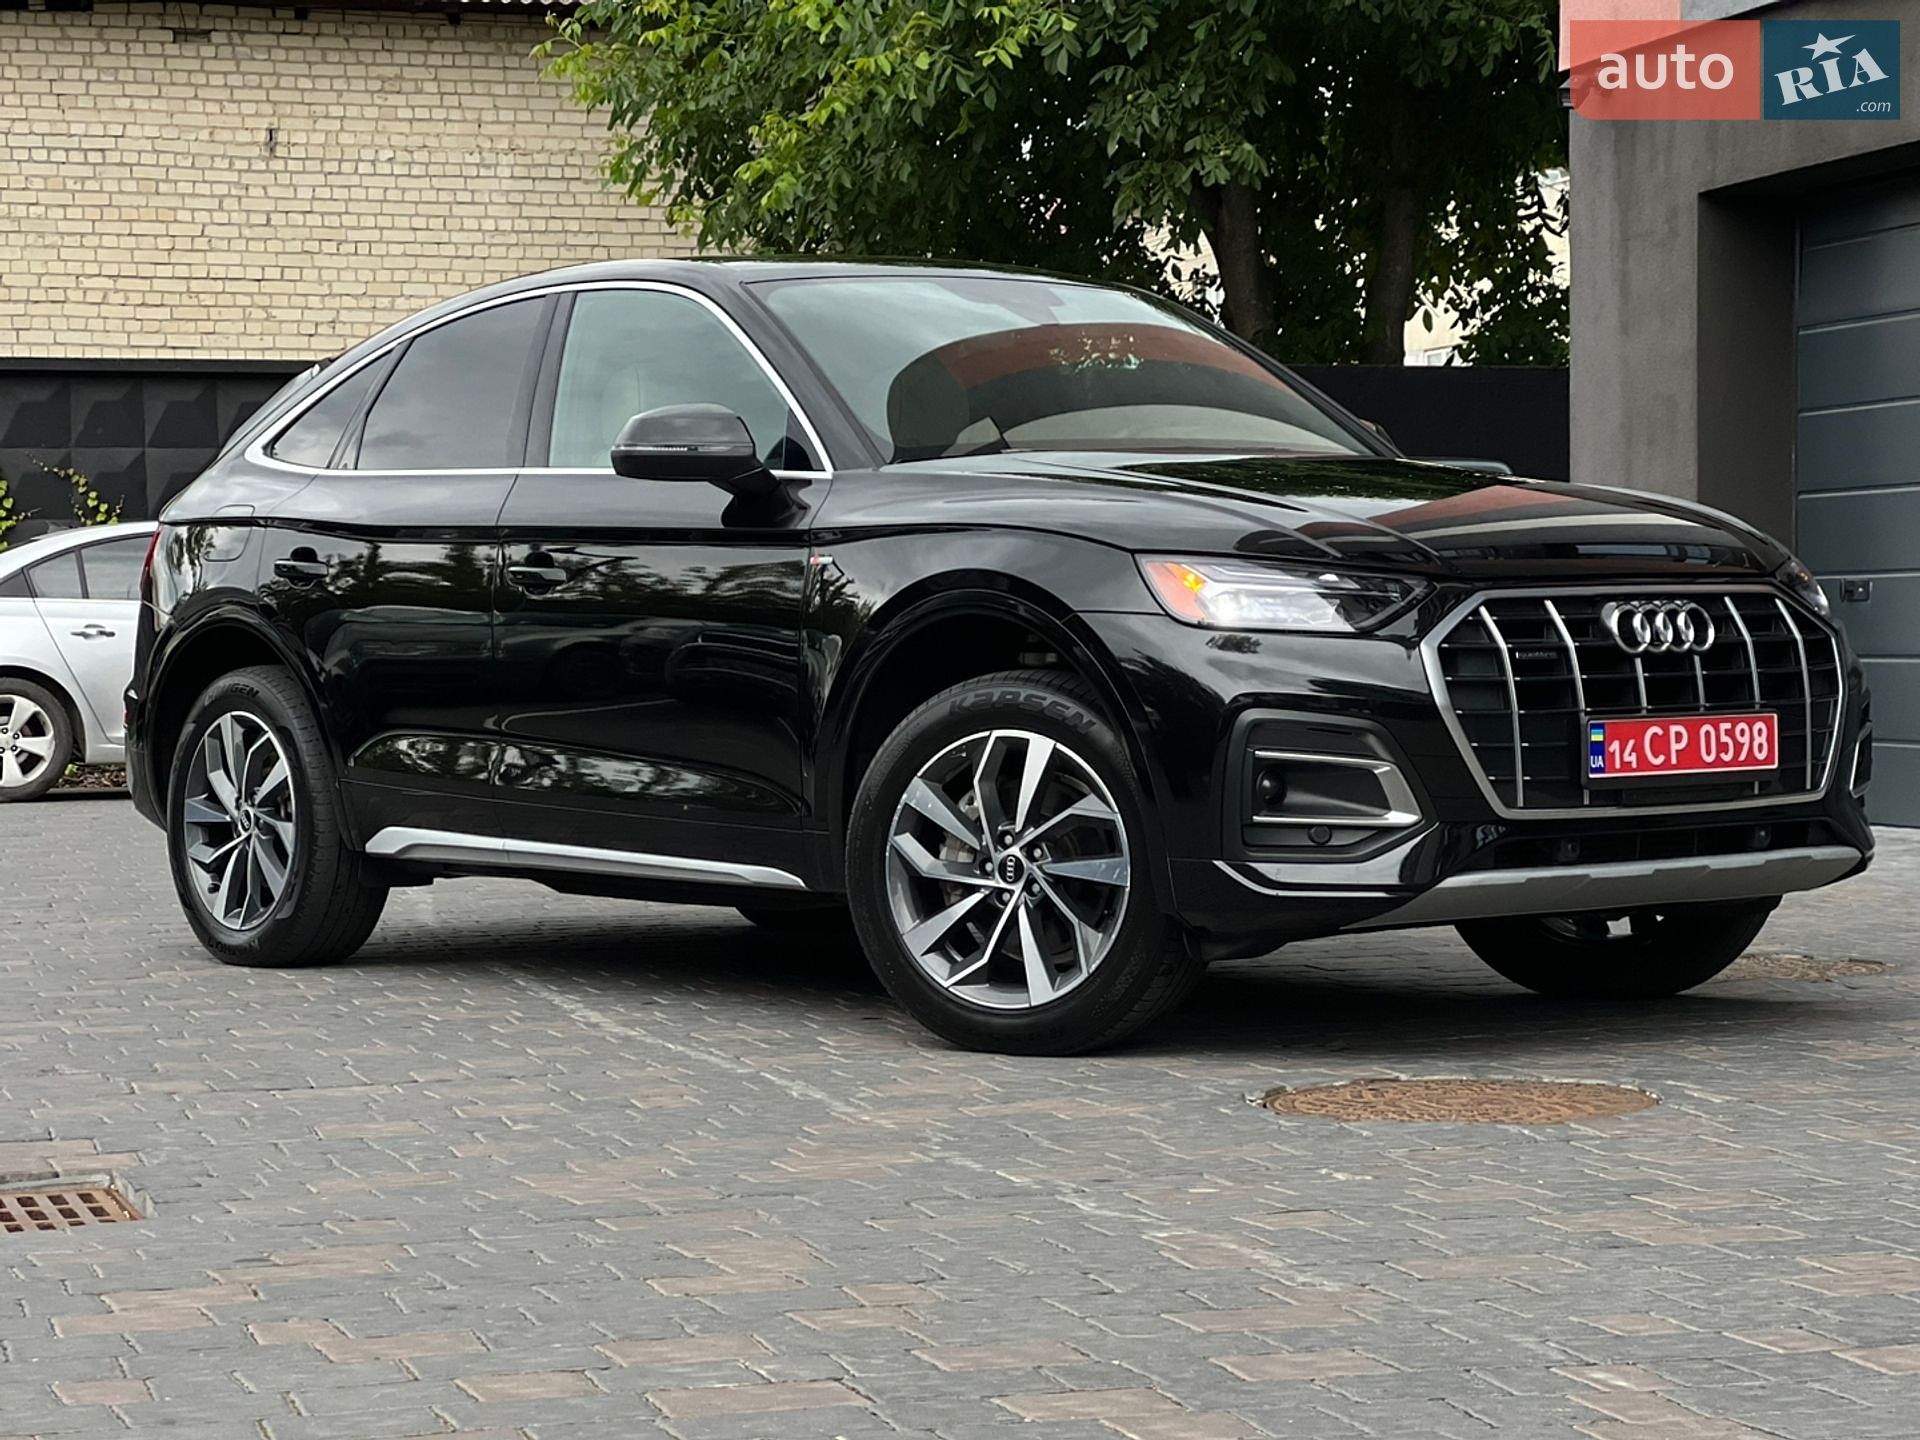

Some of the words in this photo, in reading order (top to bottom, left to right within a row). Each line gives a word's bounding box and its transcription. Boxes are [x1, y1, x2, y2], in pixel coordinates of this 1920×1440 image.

[1608, 739, 1638, 769] 14
[1643, 724, 1689, 766] CP
[1700, 721, 1769, 763] 0598
[1590, 755, 1604, 768] UA
